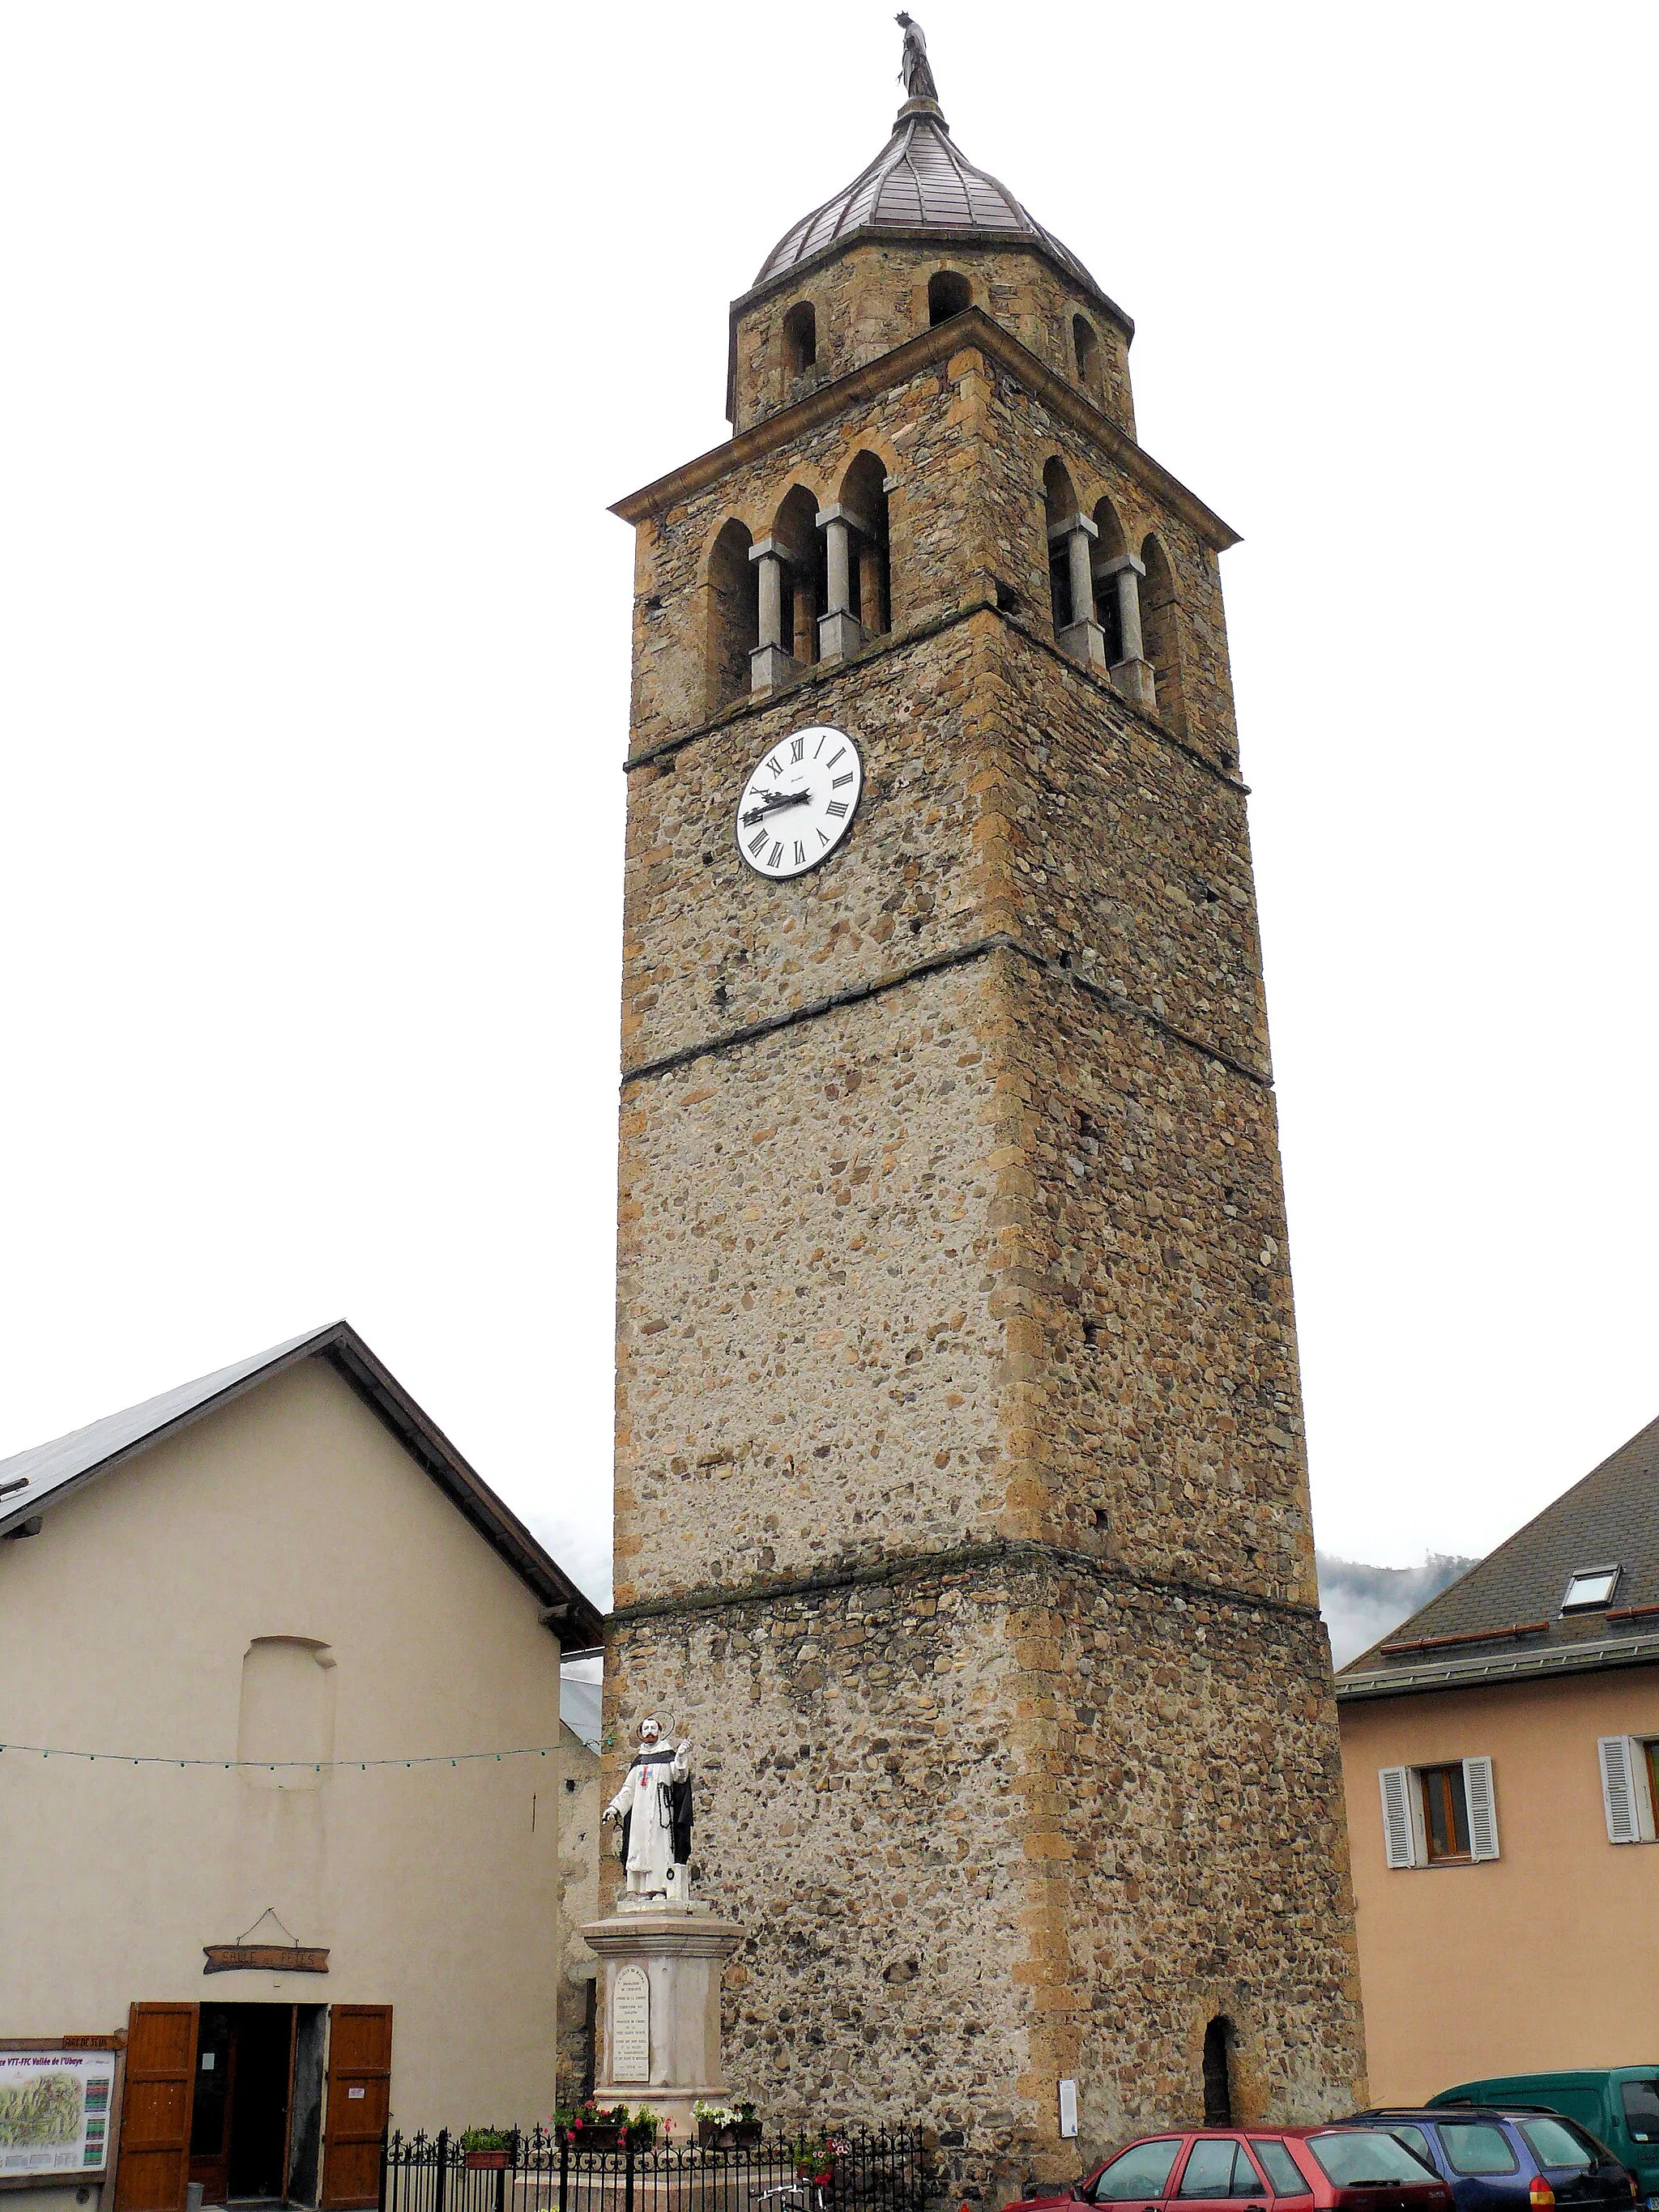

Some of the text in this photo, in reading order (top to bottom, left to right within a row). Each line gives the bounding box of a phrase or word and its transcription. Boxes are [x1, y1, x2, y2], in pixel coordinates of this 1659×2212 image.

[790, 737, 804, 765] XII
[826, 747, 847, 769] II
[765, 756, 784, 780] XI
[832, 770, 853, 790] III
[749, 786, 770, 797] X
[825, 800, 849, 820] IIII
[748, 828, 771, 859] VIII
[816, 828, 830, 848] V
[766, 841, 785, 868] VII
[794, 839, 806, 866] VI
[7, 2058, 32, 2066] VTT-FFC
[32, 2056, 51, 2065] Vallée
[52, 2057, 59, 2065] de
